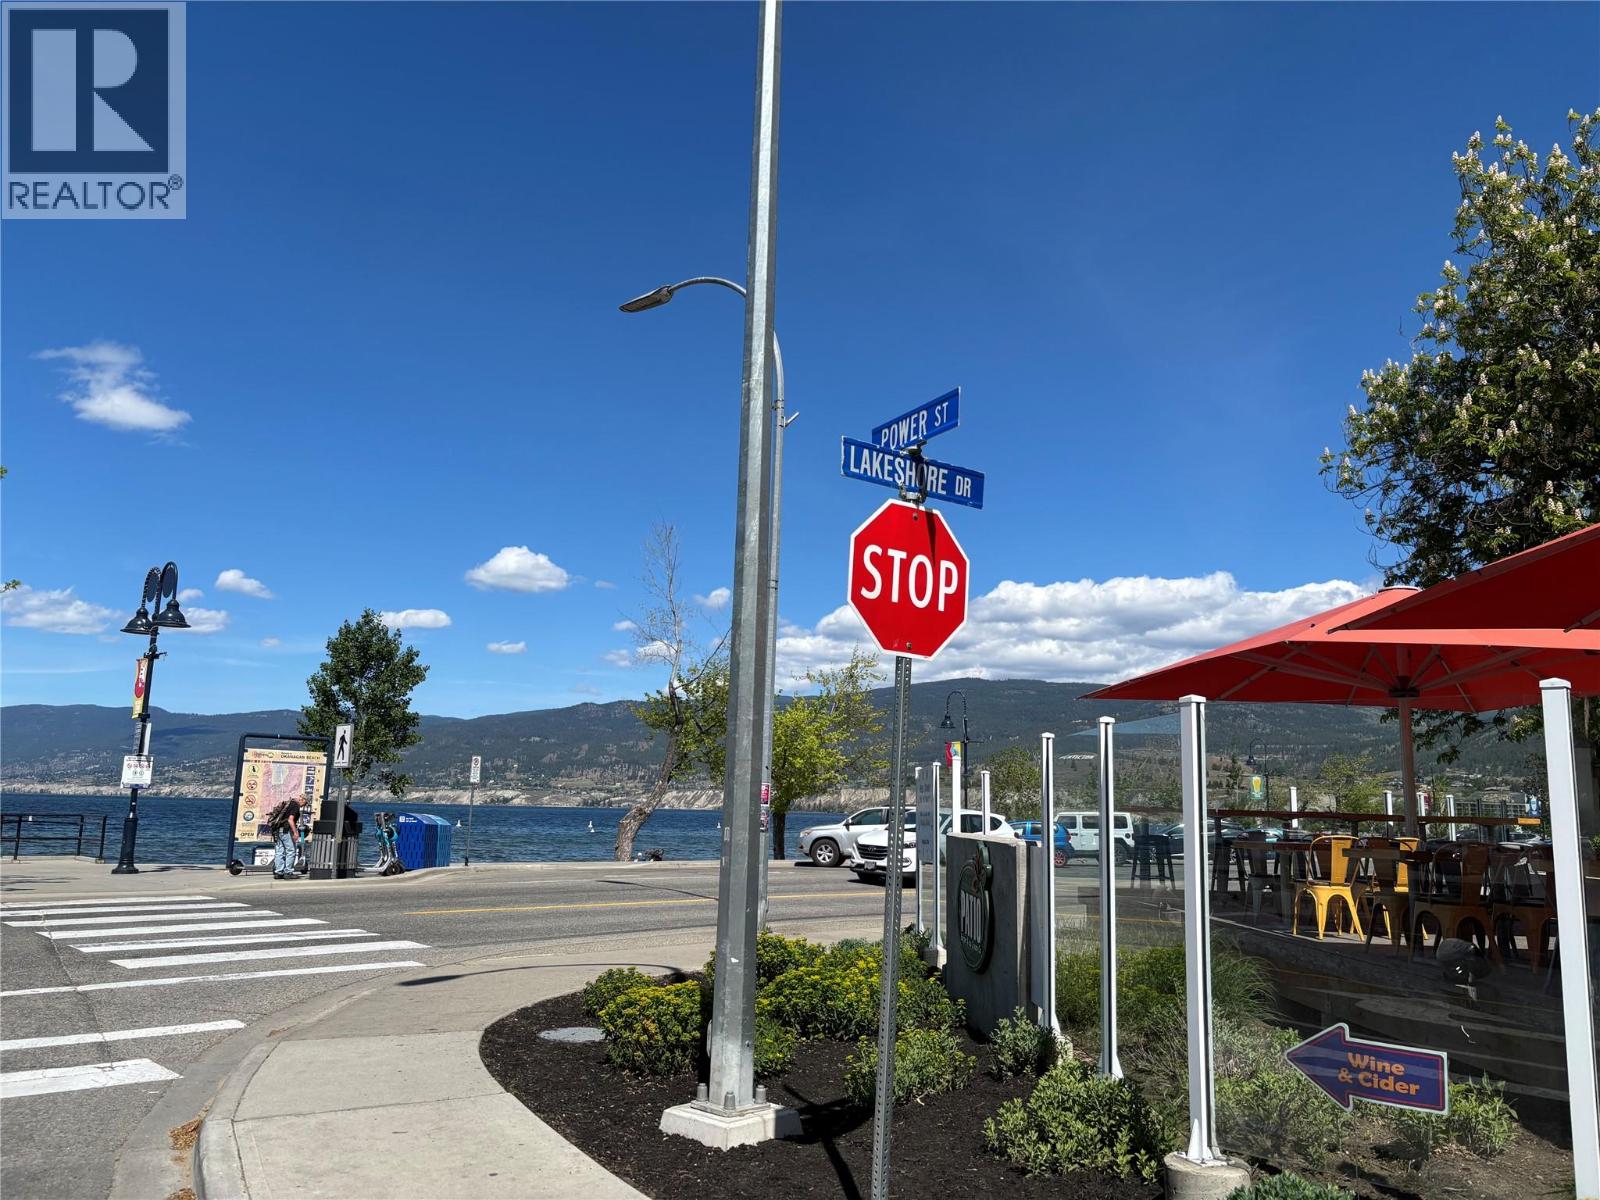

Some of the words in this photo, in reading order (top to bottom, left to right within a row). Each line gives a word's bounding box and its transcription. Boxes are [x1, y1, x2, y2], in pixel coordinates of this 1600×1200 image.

[881, 409, 927, 450] POWER
[934, 401, 949, 427] ST
[849, 445, 949, 495] LAKESHORE
[954, 475, 972, 498] DR
[860, 544, 959, 612] STOP
[960, 889, 982, 944] PATIO
[1337, 1067, 1353, 1084] &
[1358, 1071, 1420, 1095] Cider
[1347, 1052, 1405, 1076] Wine
